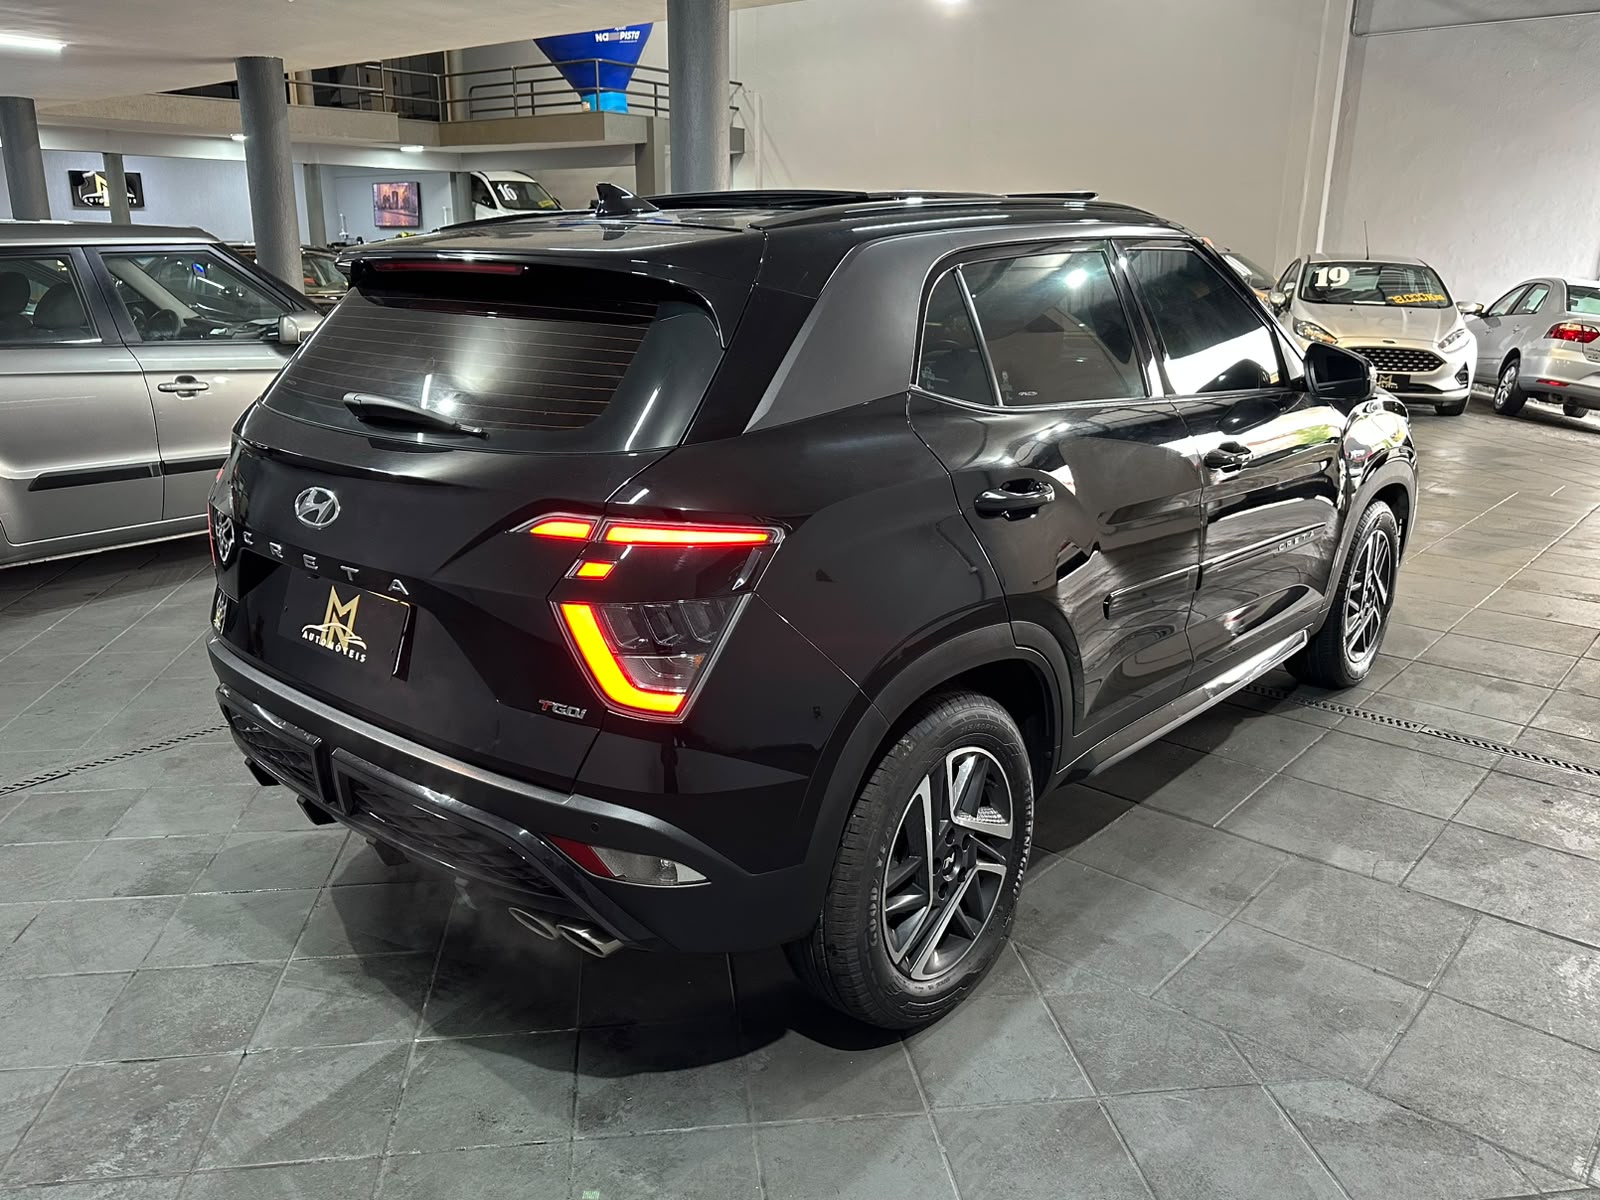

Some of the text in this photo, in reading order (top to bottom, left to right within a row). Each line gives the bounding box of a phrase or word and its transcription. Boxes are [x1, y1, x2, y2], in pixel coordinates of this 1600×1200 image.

[497, 183, 517, 201] 16
[1314, 266, 1350, 287] 19
[1280, 530, 1315, 551] CRETA
[243, 531, 410, 596] CRETA
